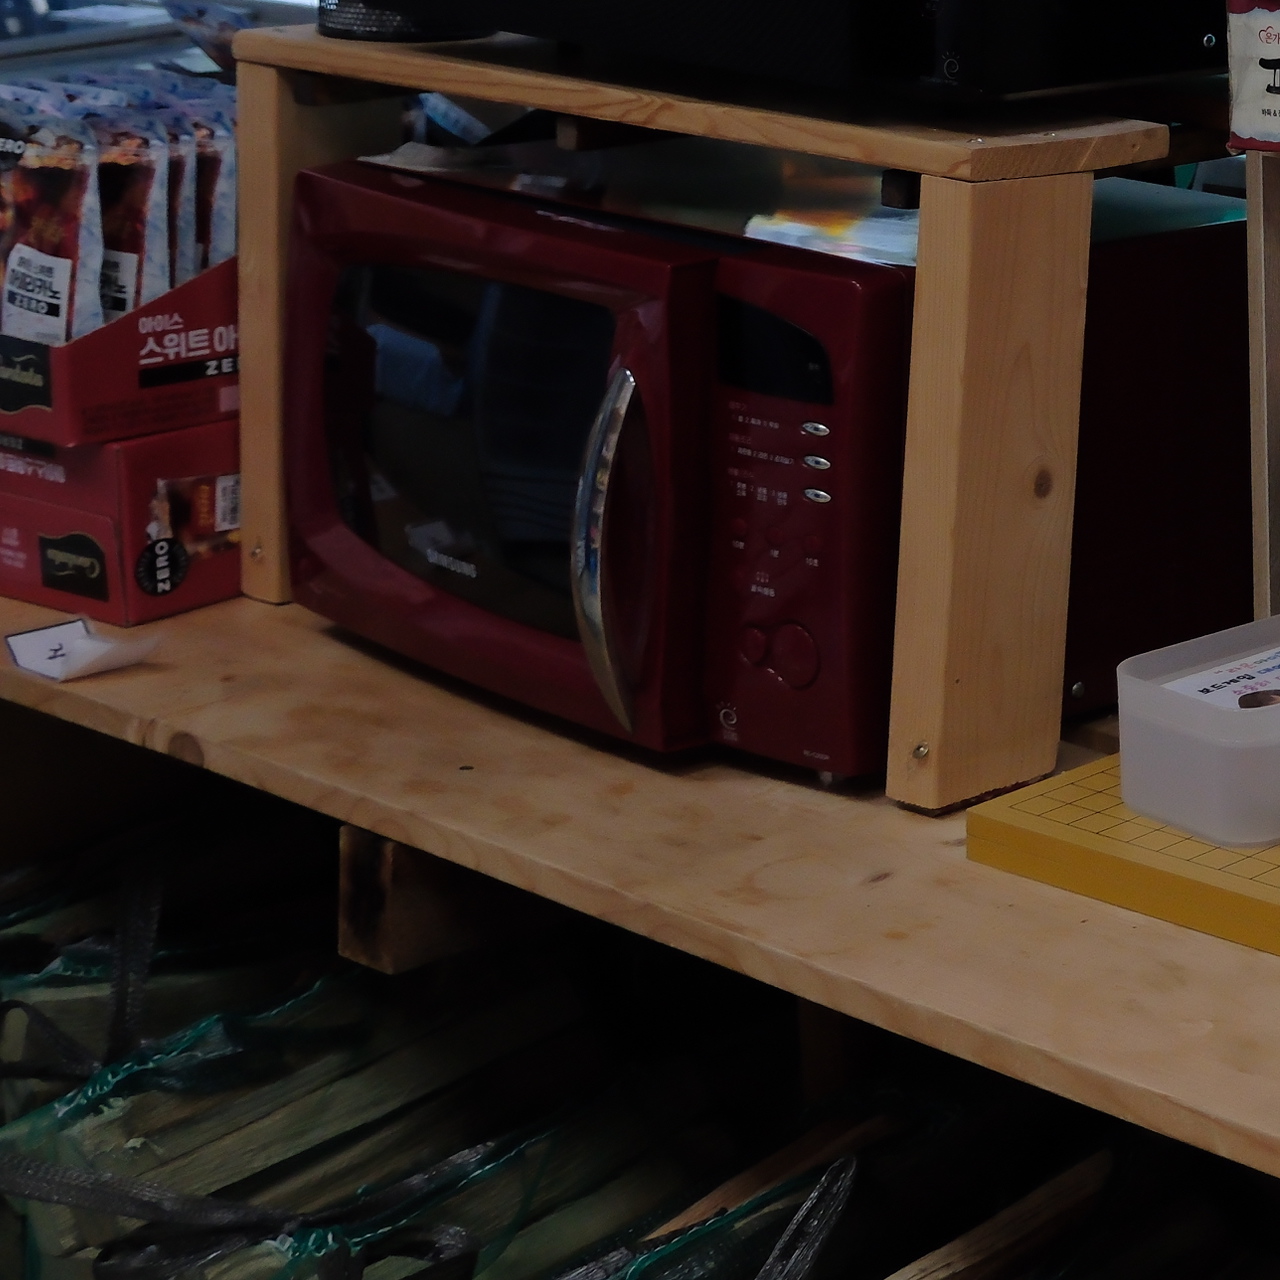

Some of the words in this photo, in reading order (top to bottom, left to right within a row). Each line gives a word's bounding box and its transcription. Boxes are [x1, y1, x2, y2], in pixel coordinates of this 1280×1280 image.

[15, 292, 49, 314] ZERO
[138, 313, 184, 333] 아이스
[139, 329, 210, 365] 스위트
[1198, 673, 1256, 695] 보드게임
